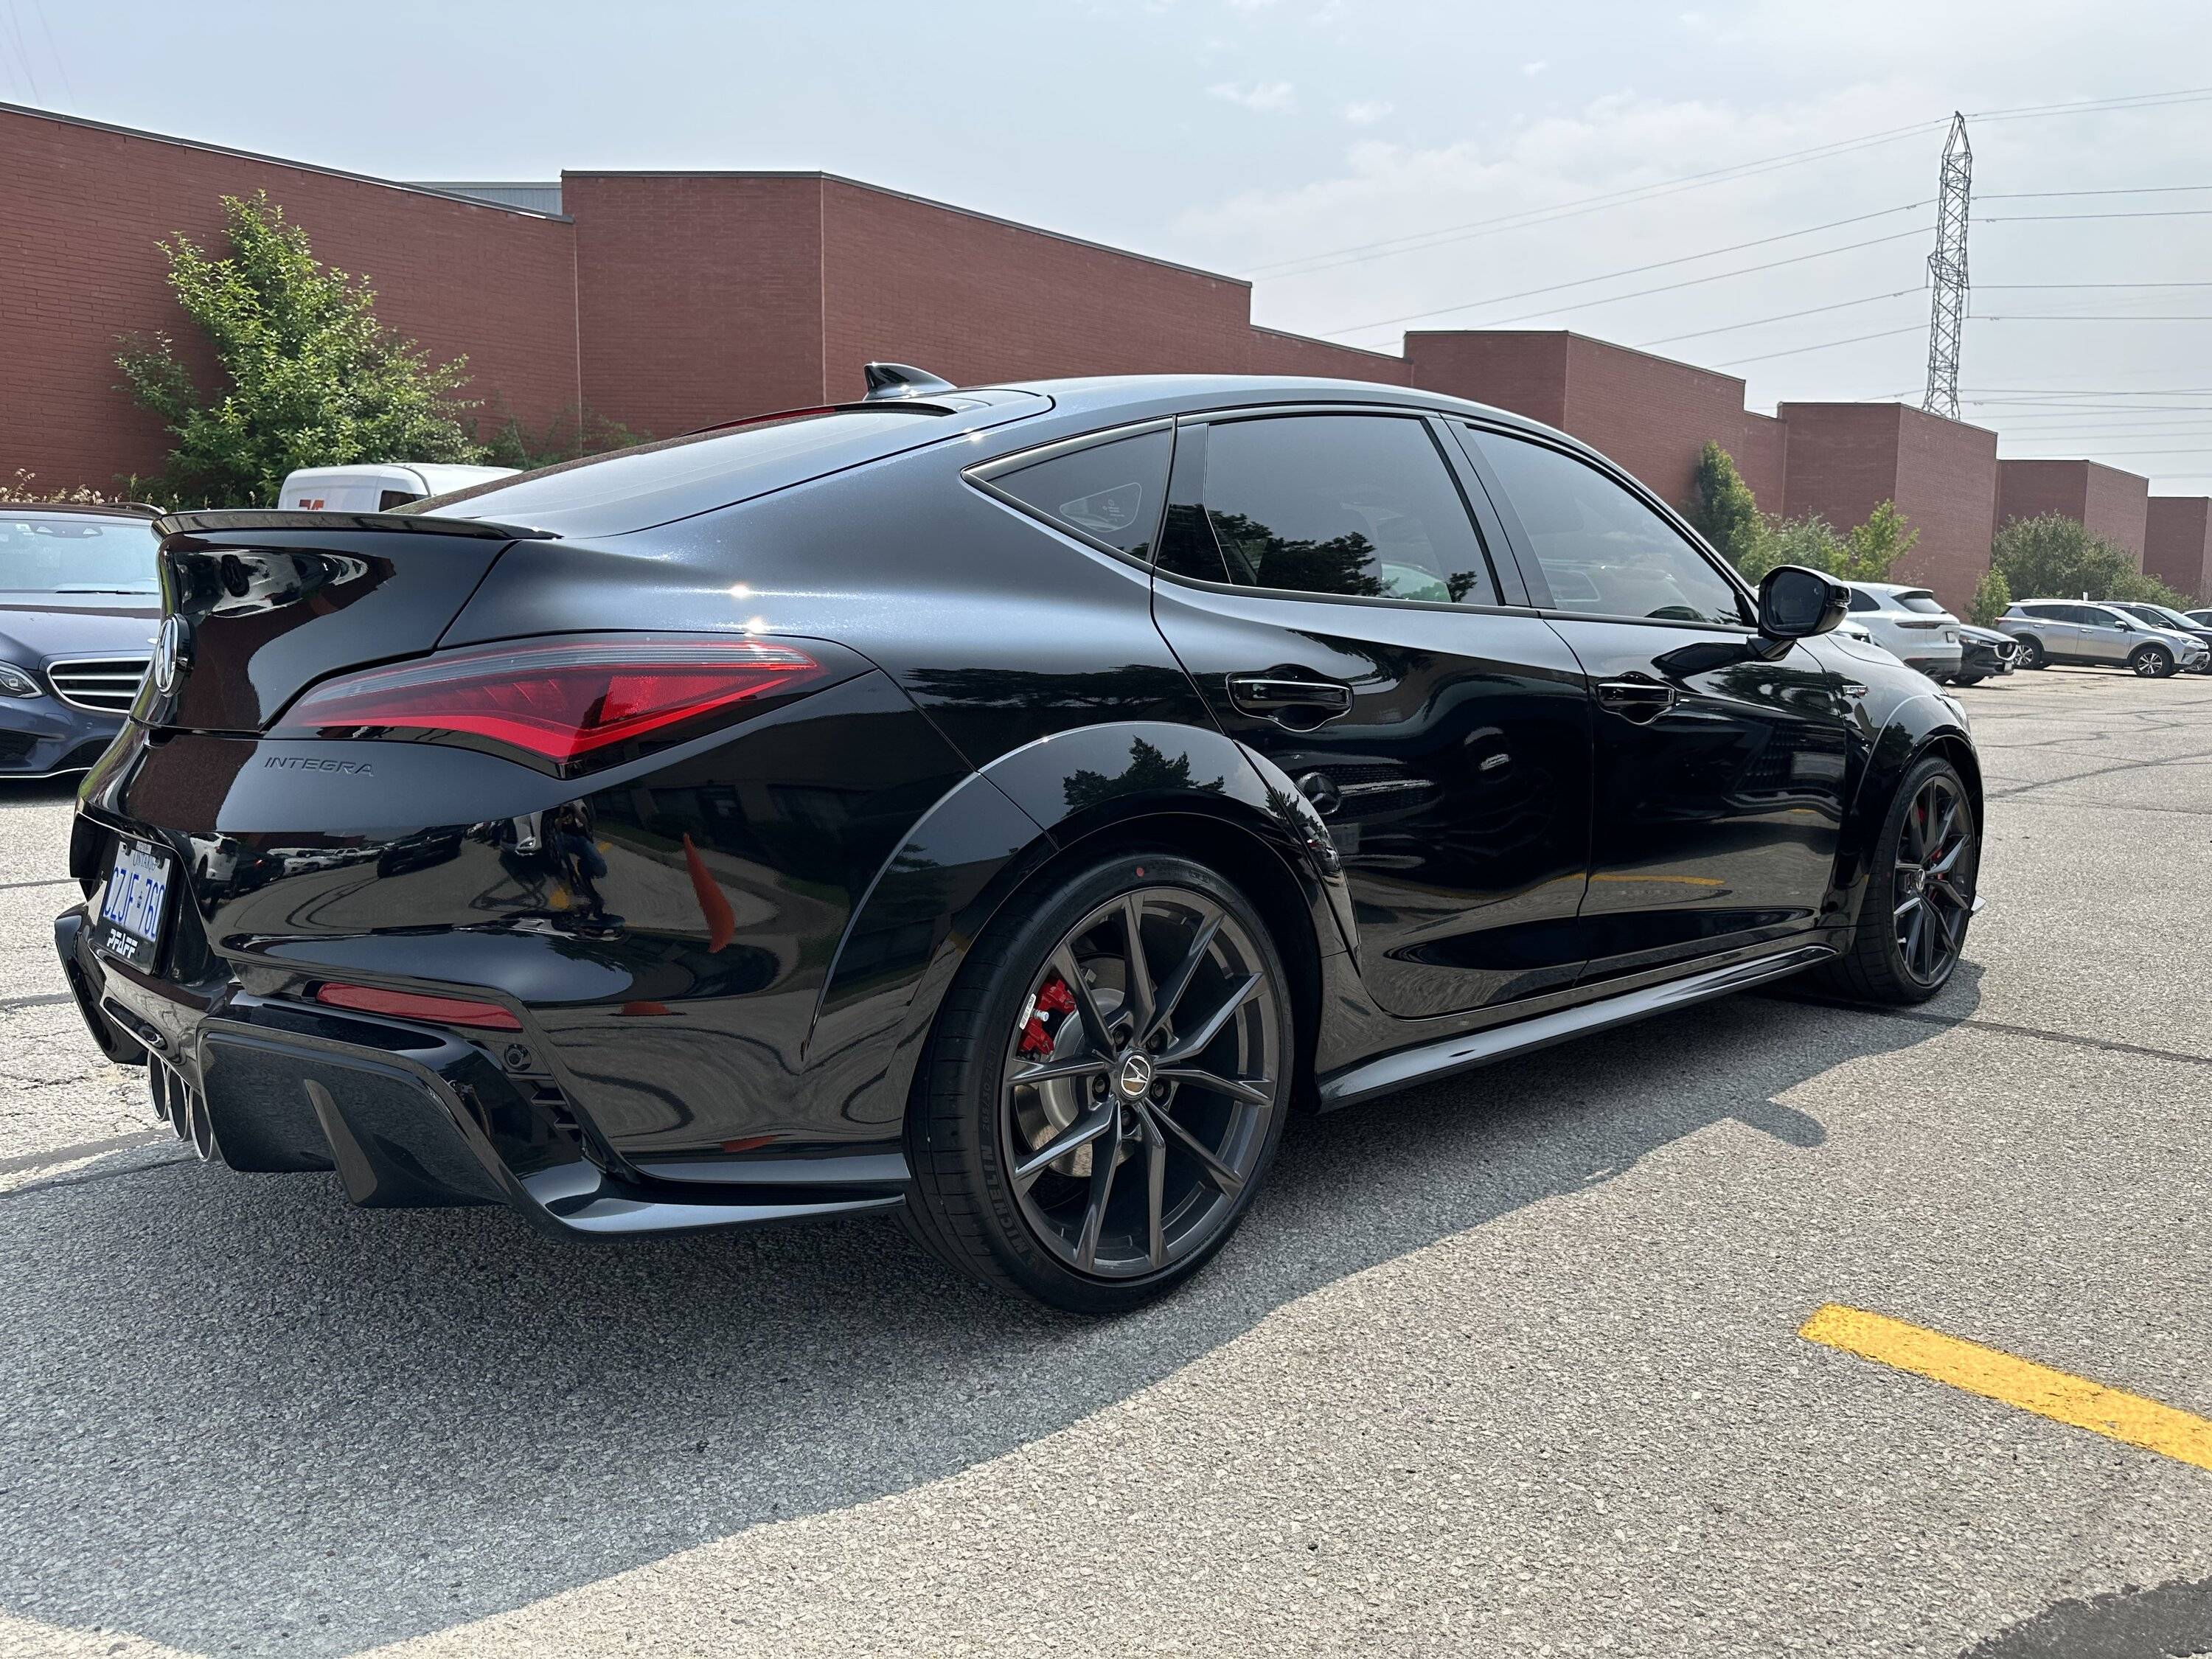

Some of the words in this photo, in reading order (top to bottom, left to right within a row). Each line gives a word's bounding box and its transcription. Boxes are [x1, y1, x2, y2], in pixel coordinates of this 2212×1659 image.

[264, 757, 374, 776] INTEGRA
[138, 878, 165, 938] 760
[106, 928, 139, 959] PFAFF
[981, 1144, 1030, 1254] MICHELIN
